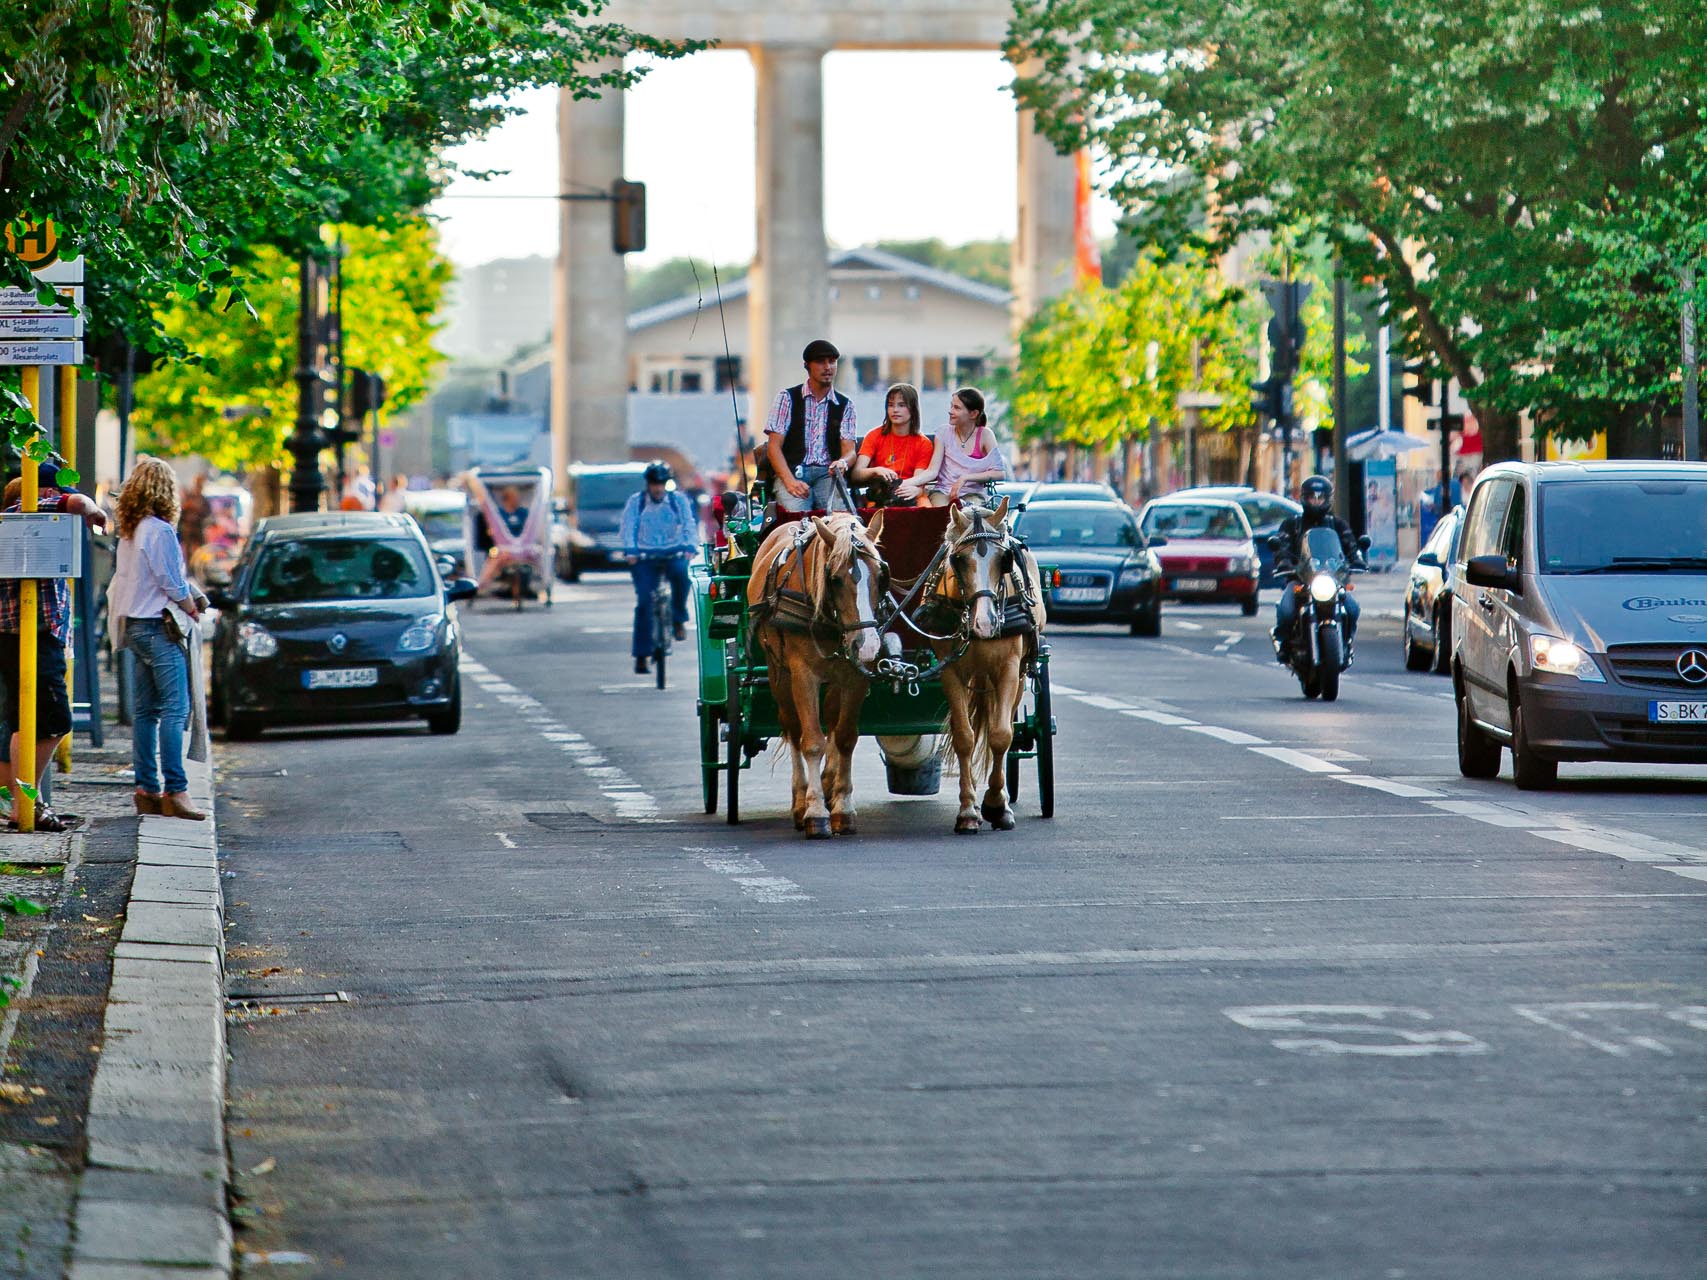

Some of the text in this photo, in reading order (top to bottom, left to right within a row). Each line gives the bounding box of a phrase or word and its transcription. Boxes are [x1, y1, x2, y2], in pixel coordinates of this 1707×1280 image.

[13, 325, 59, 333] Alexanderplatz
[12, 353, 58, 361] Alexanderplatz
[1659, 704, 1668, 718] S
[1679, 704, 1698, 718] BK
